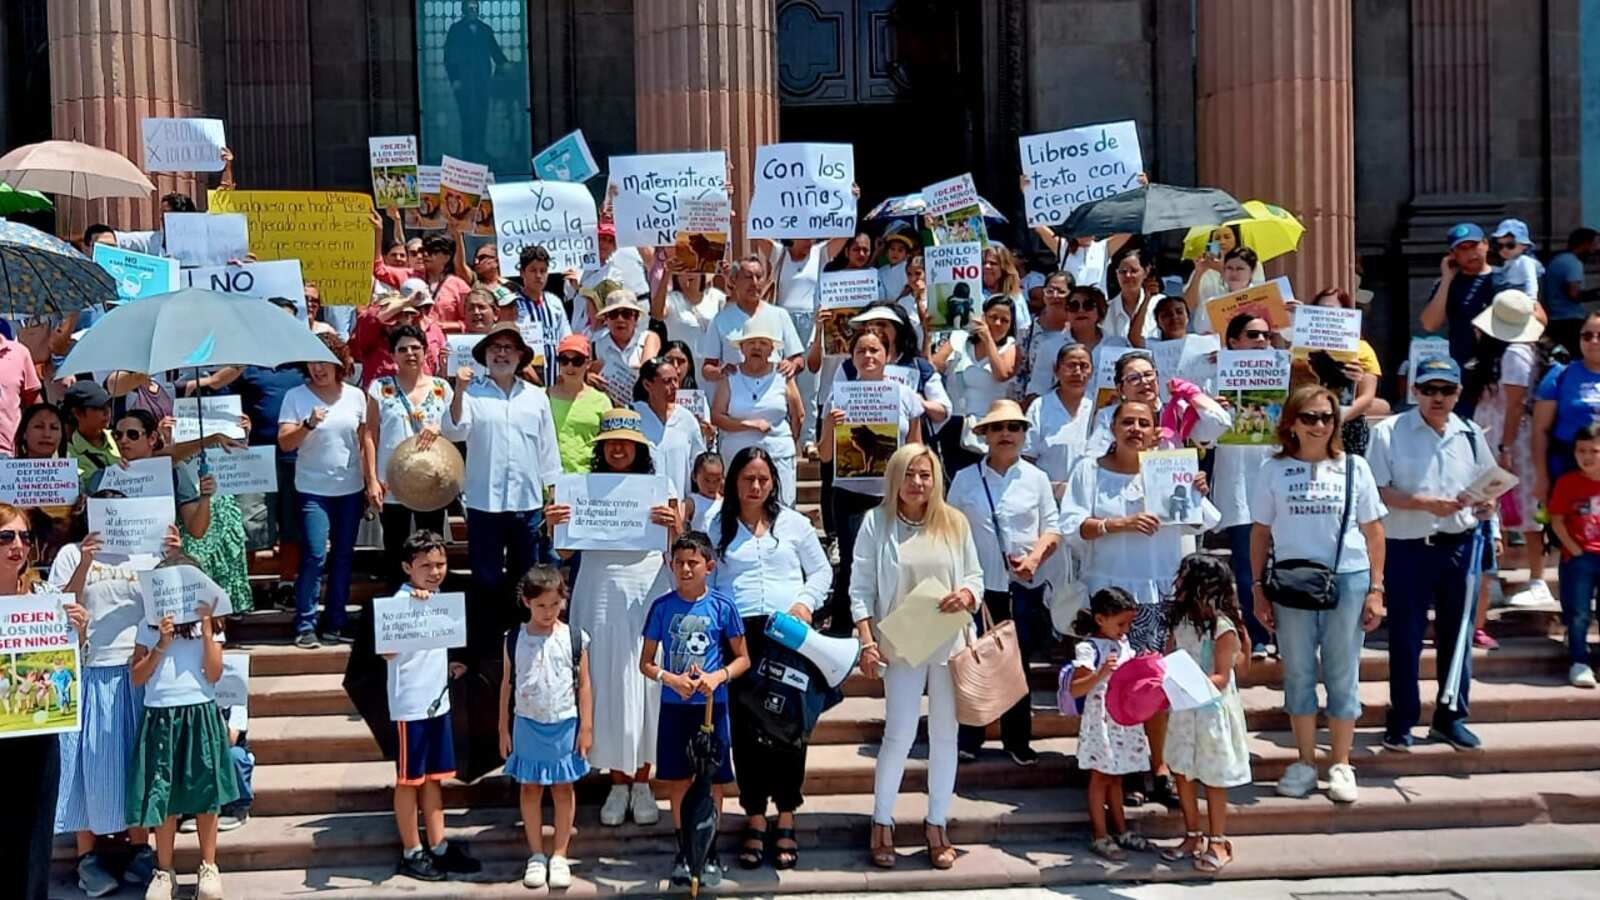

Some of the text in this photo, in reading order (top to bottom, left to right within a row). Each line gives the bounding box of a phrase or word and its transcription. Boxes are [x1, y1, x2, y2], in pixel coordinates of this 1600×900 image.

[1028, 129, 1119, 165] Libros de
[763, 153, 845, 180] Con los
[1032, 161, 1126, 190] texto con
[530, 186, 555, 211] Yo
[1033, 184, 1118, 209] ciencias
[501, 210, 583, 235] cuido la
[752, 212, 855, 230] no se metan
[1035, 210, 1062, 222] no
[956, 246, 979, 256] LOS
[565, 252, 597, 269] hijos
[952, 265, 979, 281] NO
[210, 270, 254, 293] NO
[1220, 369, 1227, 377] A
[1229, 369, 1251, 377] LOS
[1225, 378, 1247, 386] SER
[6, 461, 32, 469] COMO
[1172, 472, 1194, 483] NO
[17, 482, 30, 490] UN
[575, 517, 585, 526] de
